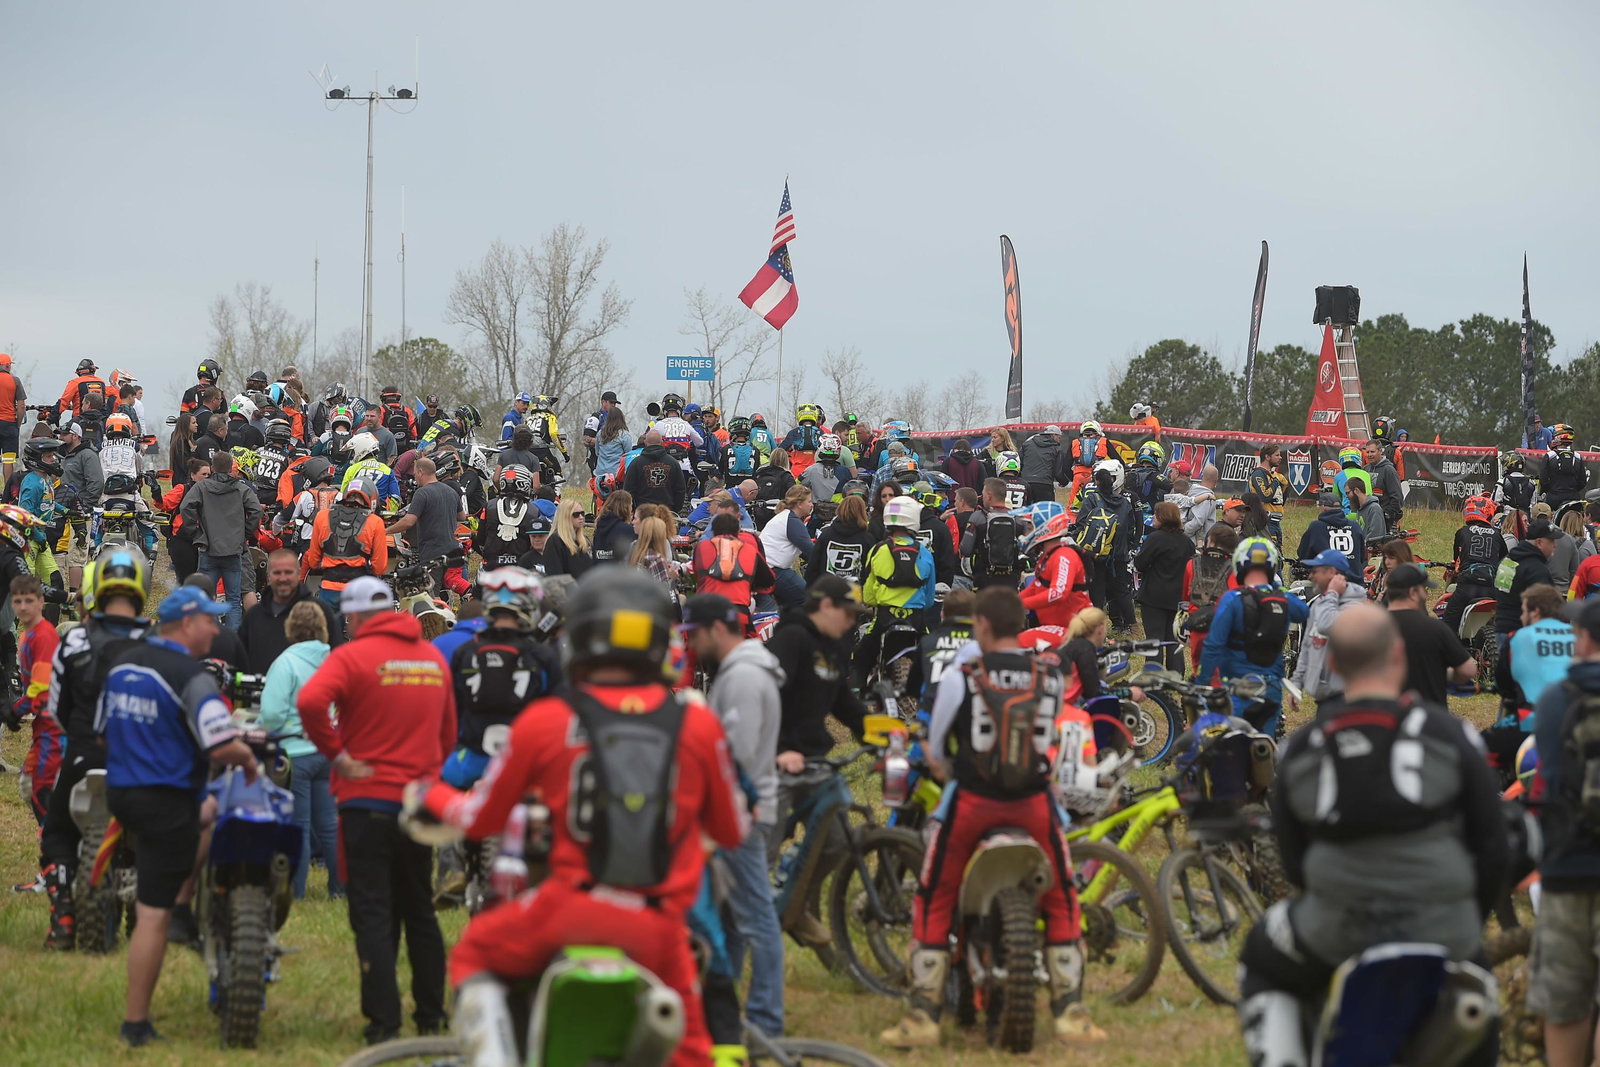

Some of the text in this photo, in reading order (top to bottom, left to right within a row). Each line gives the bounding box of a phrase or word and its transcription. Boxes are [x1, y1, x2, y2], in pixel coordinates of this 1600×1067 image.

[668, 360, 712, 368] ENGINES
[680, 369, 700, 378] OFF
[664, 423, 687, 438] 282
[756, 432, 768, 443] 57
[102, 446, 135, 468] 433
[257, 459, 281, 479] 623
[1293, 464, 1306, 486] X
[1466, 462, 1491, 475] RACING
[1469, 535, 1493, 559] 21
[498, 555, 517, 564] FXR
[834, 551, 855, 570] 5
